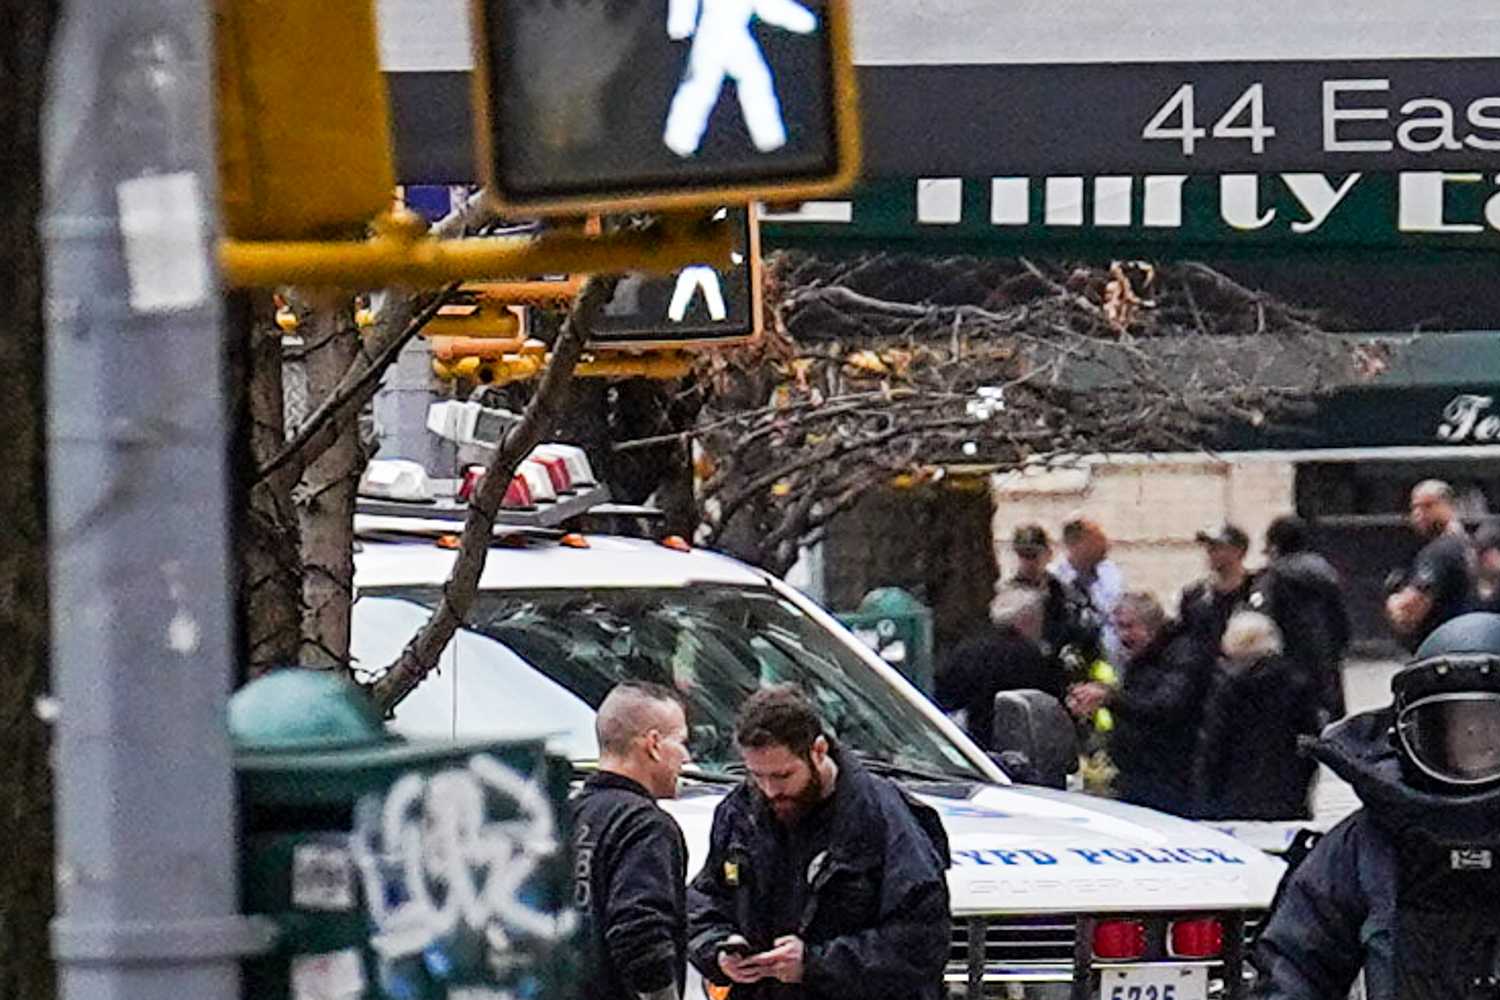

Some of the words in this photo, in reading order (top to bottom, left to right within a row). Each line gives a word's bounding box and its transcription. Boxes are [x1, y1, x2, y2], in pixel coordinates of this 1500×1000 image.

[1142, 82, 1276, 155] 44
[950, 847, 1060, 866] YPD
[1067, 846, 1245, 866] POLICE
